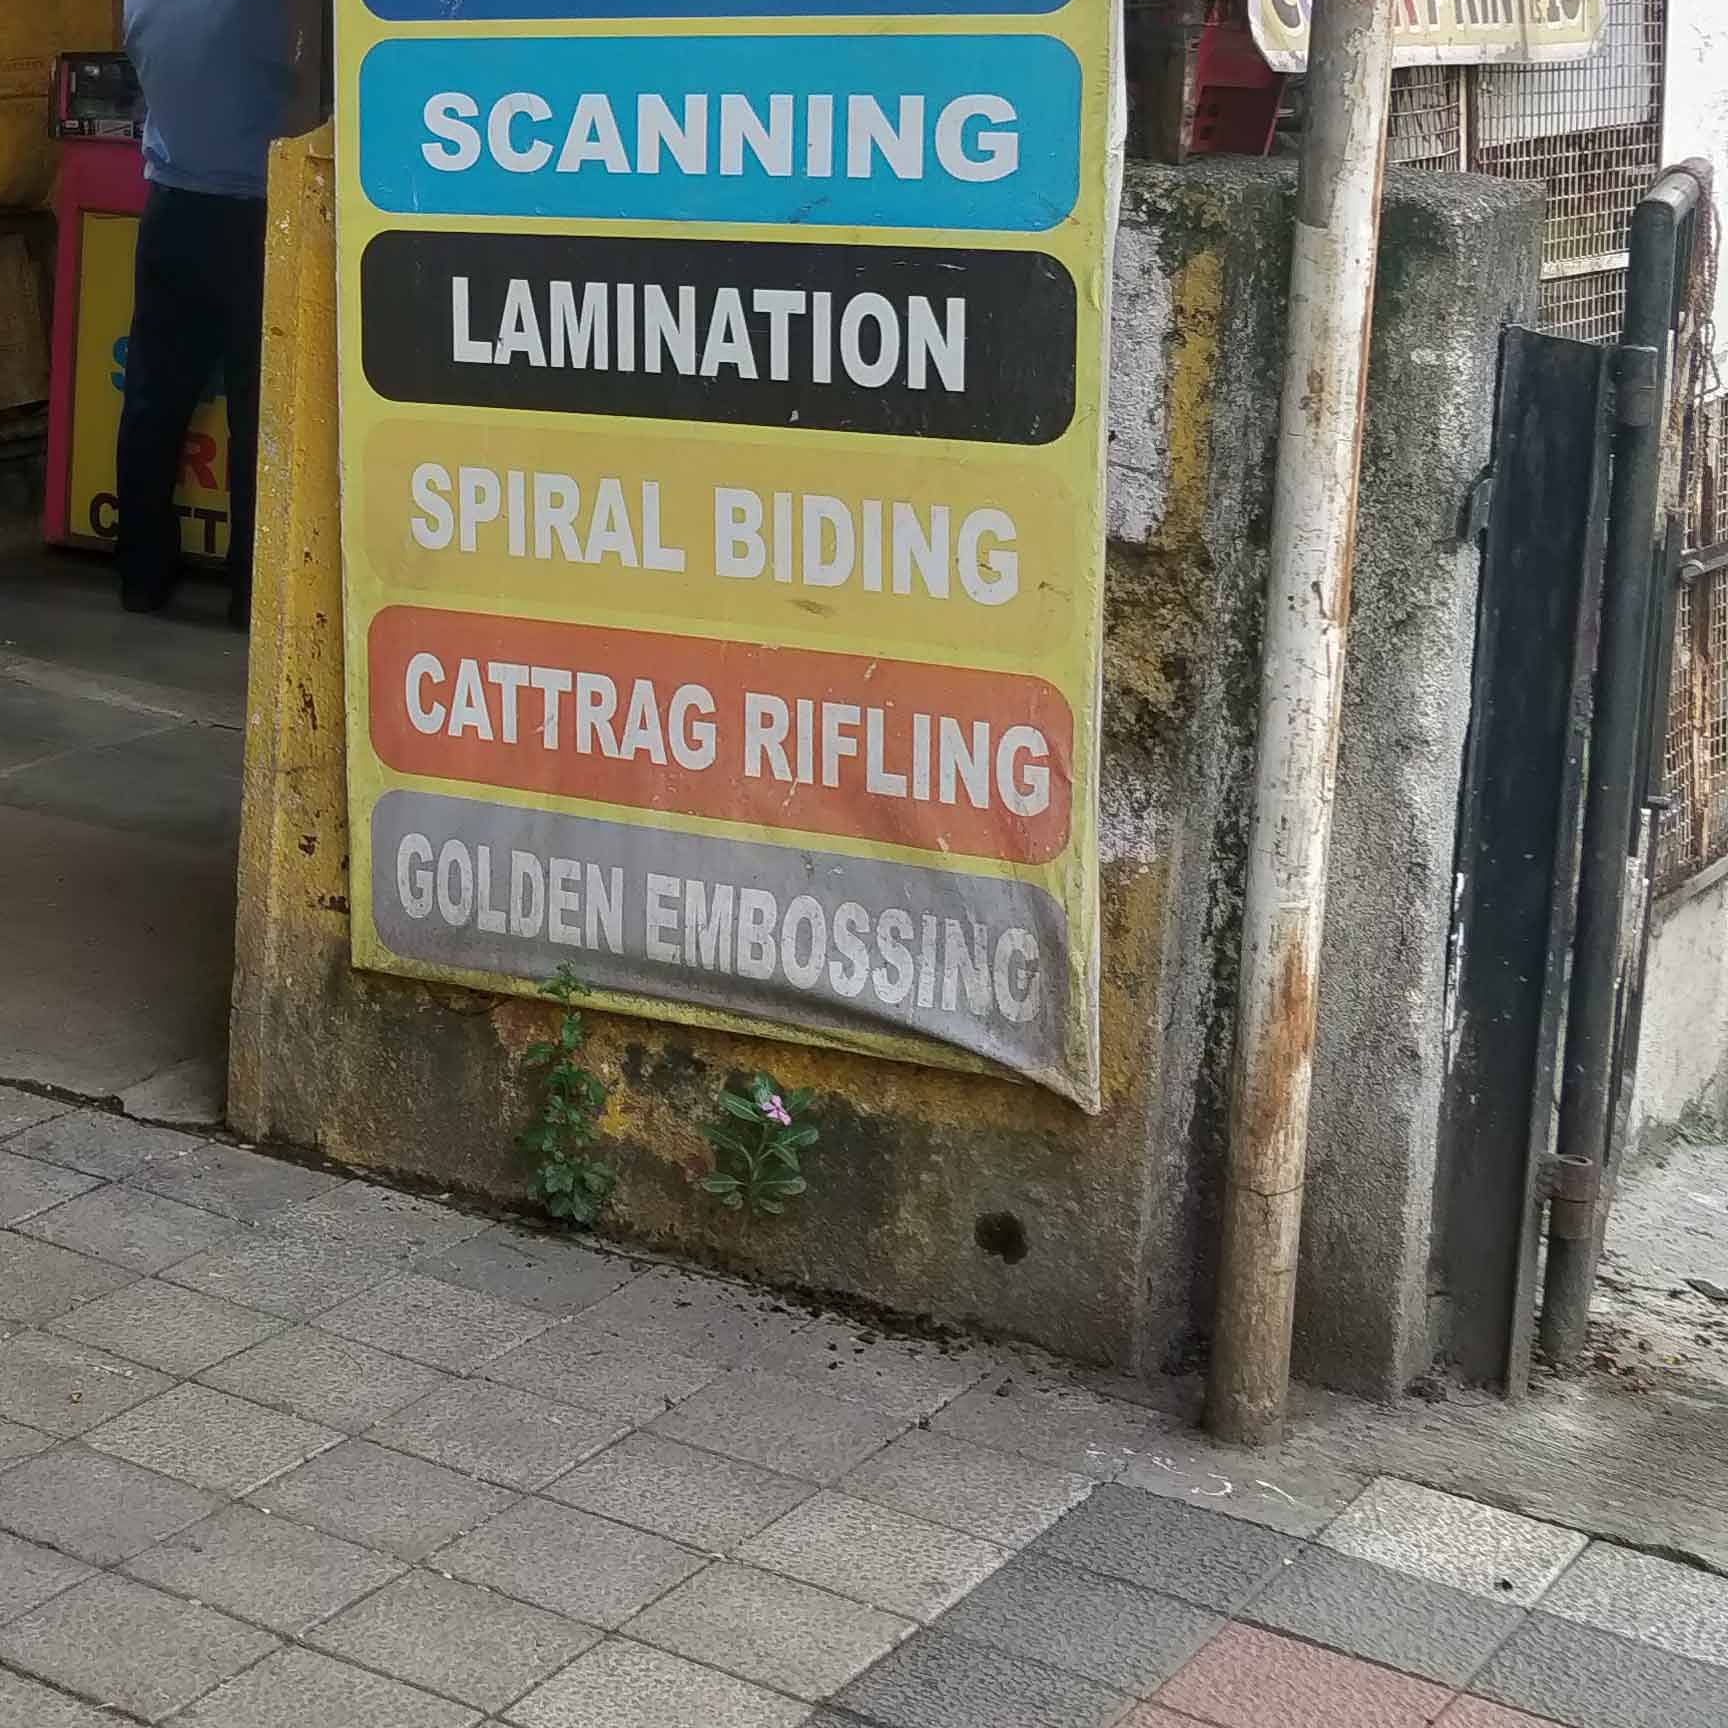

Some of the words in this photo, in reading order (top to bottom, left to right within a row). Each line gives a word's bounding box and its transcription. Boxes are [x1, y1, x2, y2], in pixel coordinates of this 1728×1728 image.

[420, 91, 1020, 183] SCANNING
[452, 275, 966, 393] LAMINATION
[410, 462, 686, 572] SPIRAL
[714, 486, 1020, 606] BIDING
[403, 652, 718, 772] CATTRAG
[744, 690, 1052, 817] RIFLING
[395, 831, 625, 955] GOLDEN
[645, 871, 1042, 1024] EMBOSSING
